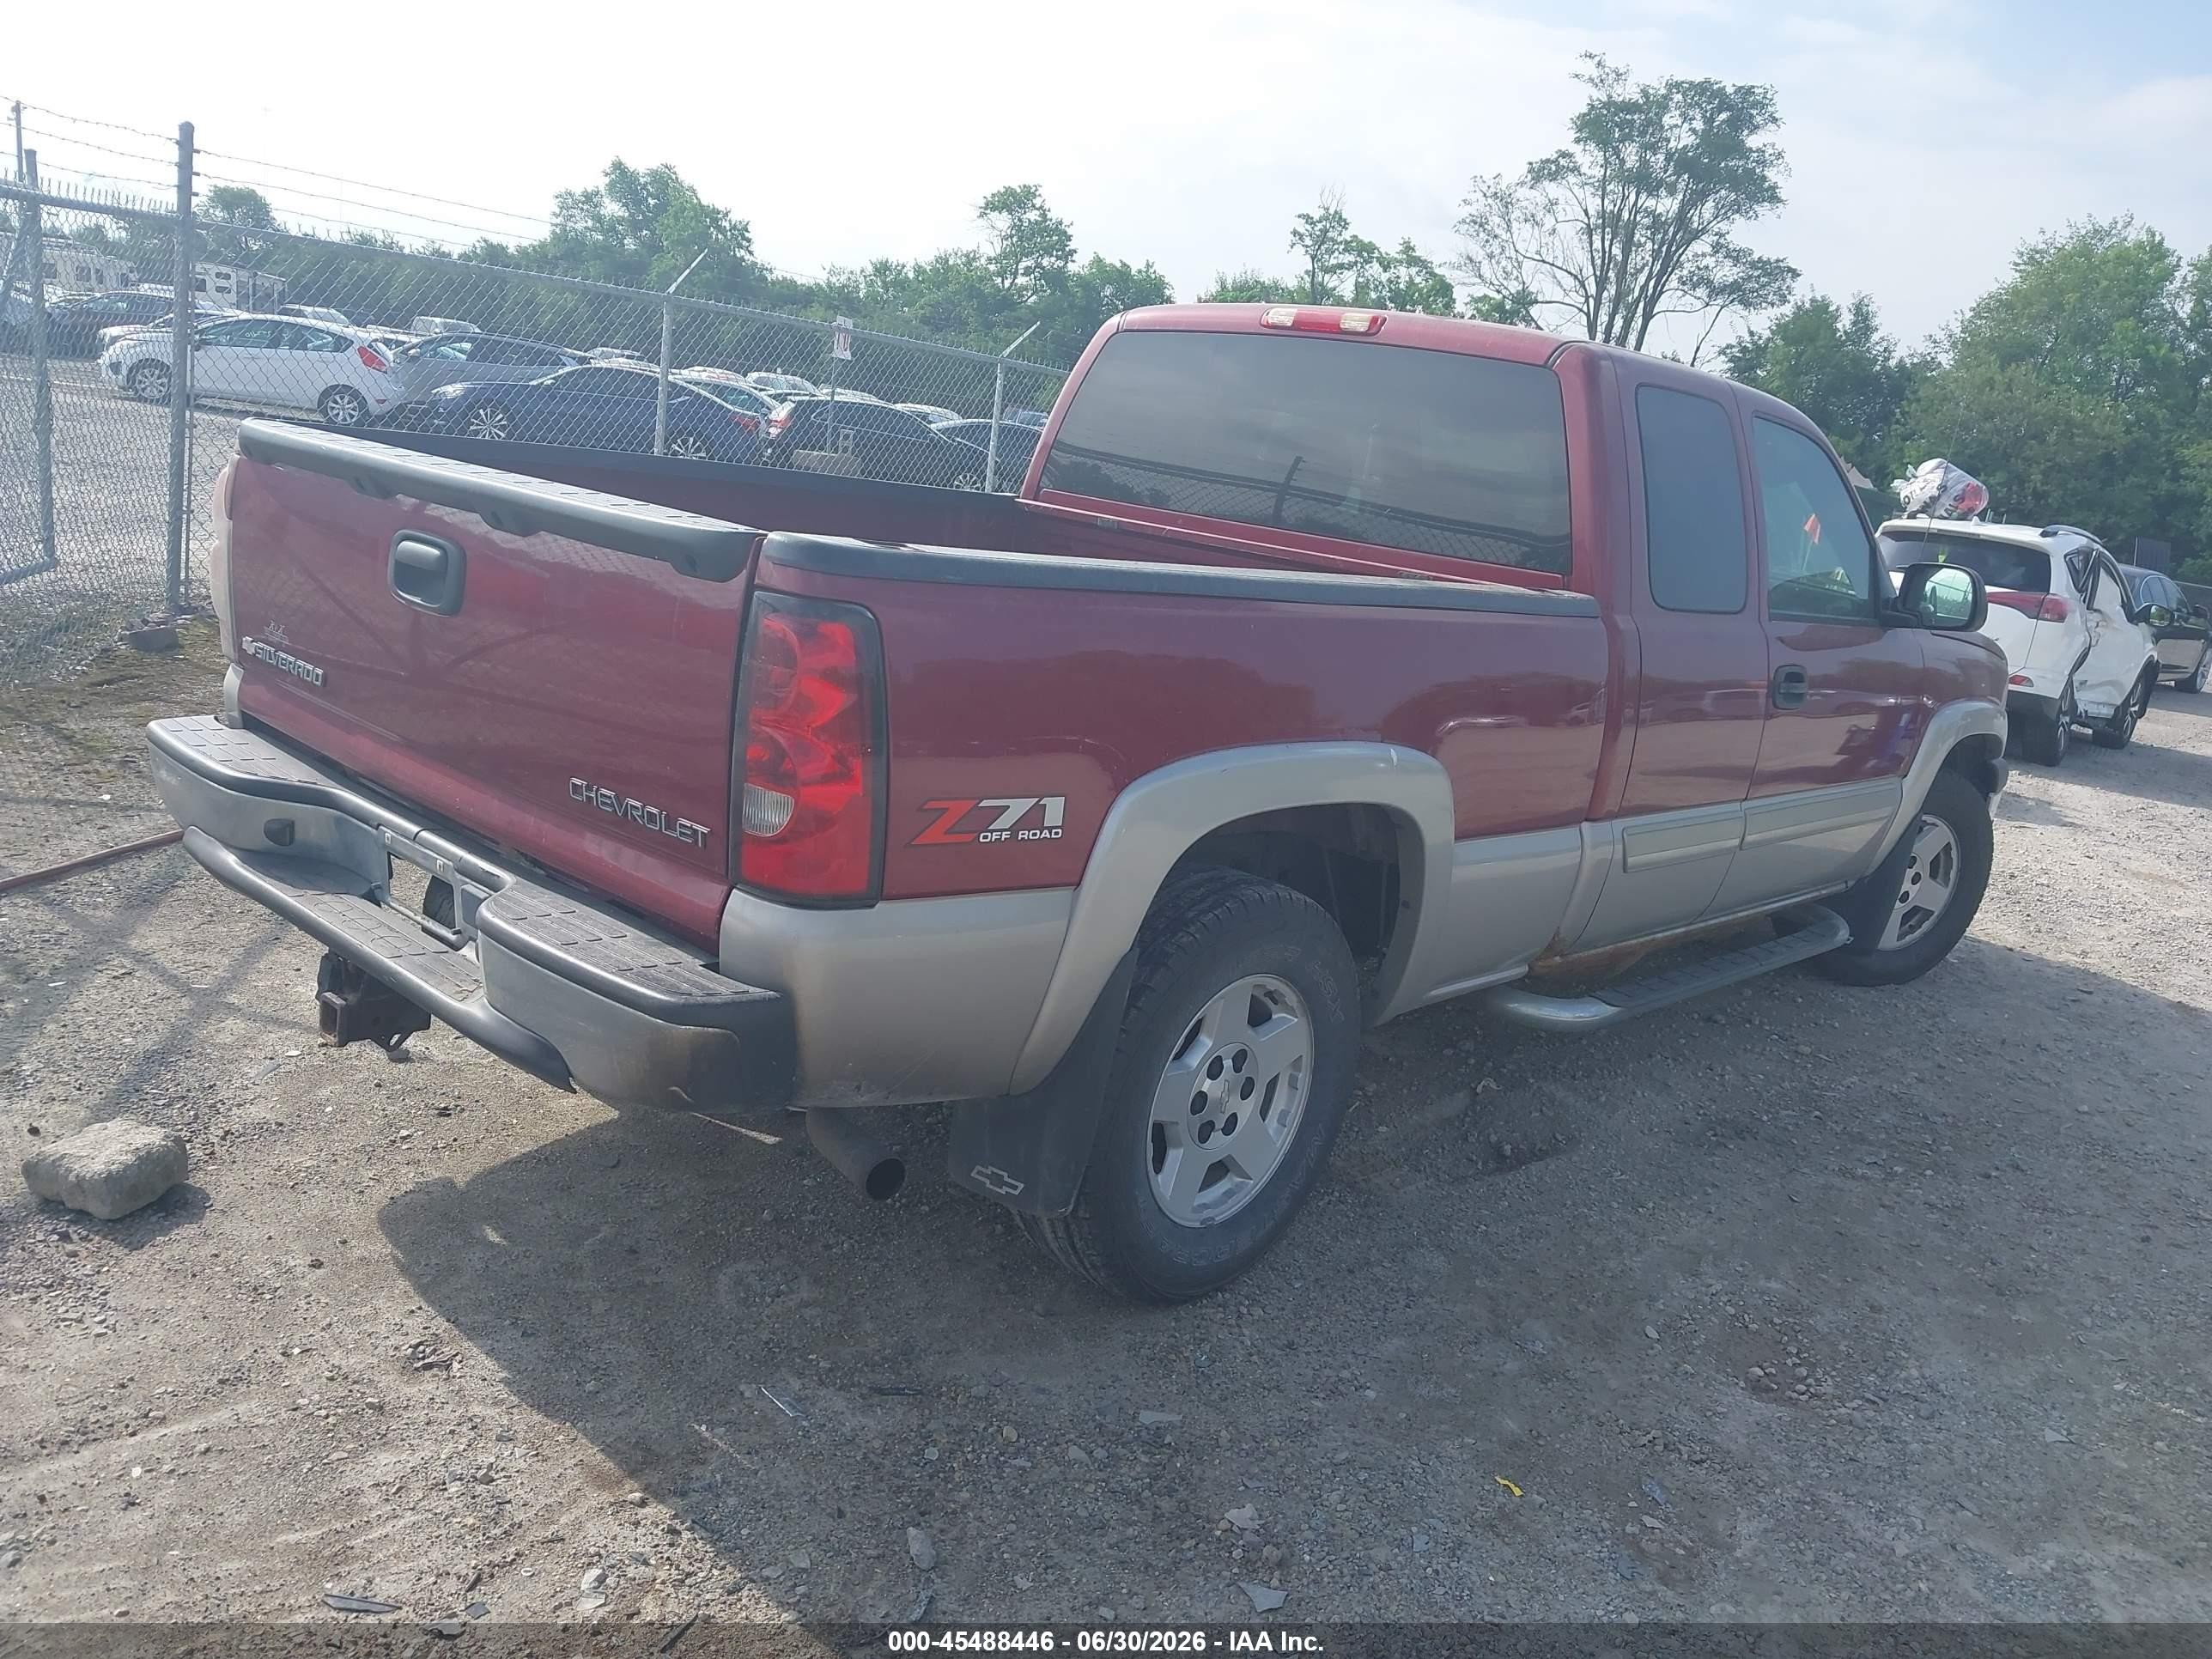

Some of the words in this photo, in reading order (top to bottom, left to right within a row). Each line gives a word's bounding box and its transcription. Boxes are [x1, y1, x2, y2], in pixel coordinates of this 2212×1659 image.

[253, 641, 324, 687] SILVERADO
[568, 776, 712, 849] CHEVROLET
[910, 796, 1066, 845] Z71
[978, 830, 1012, 843] OFF
[1017, 828, 1063, 841] ROAD
